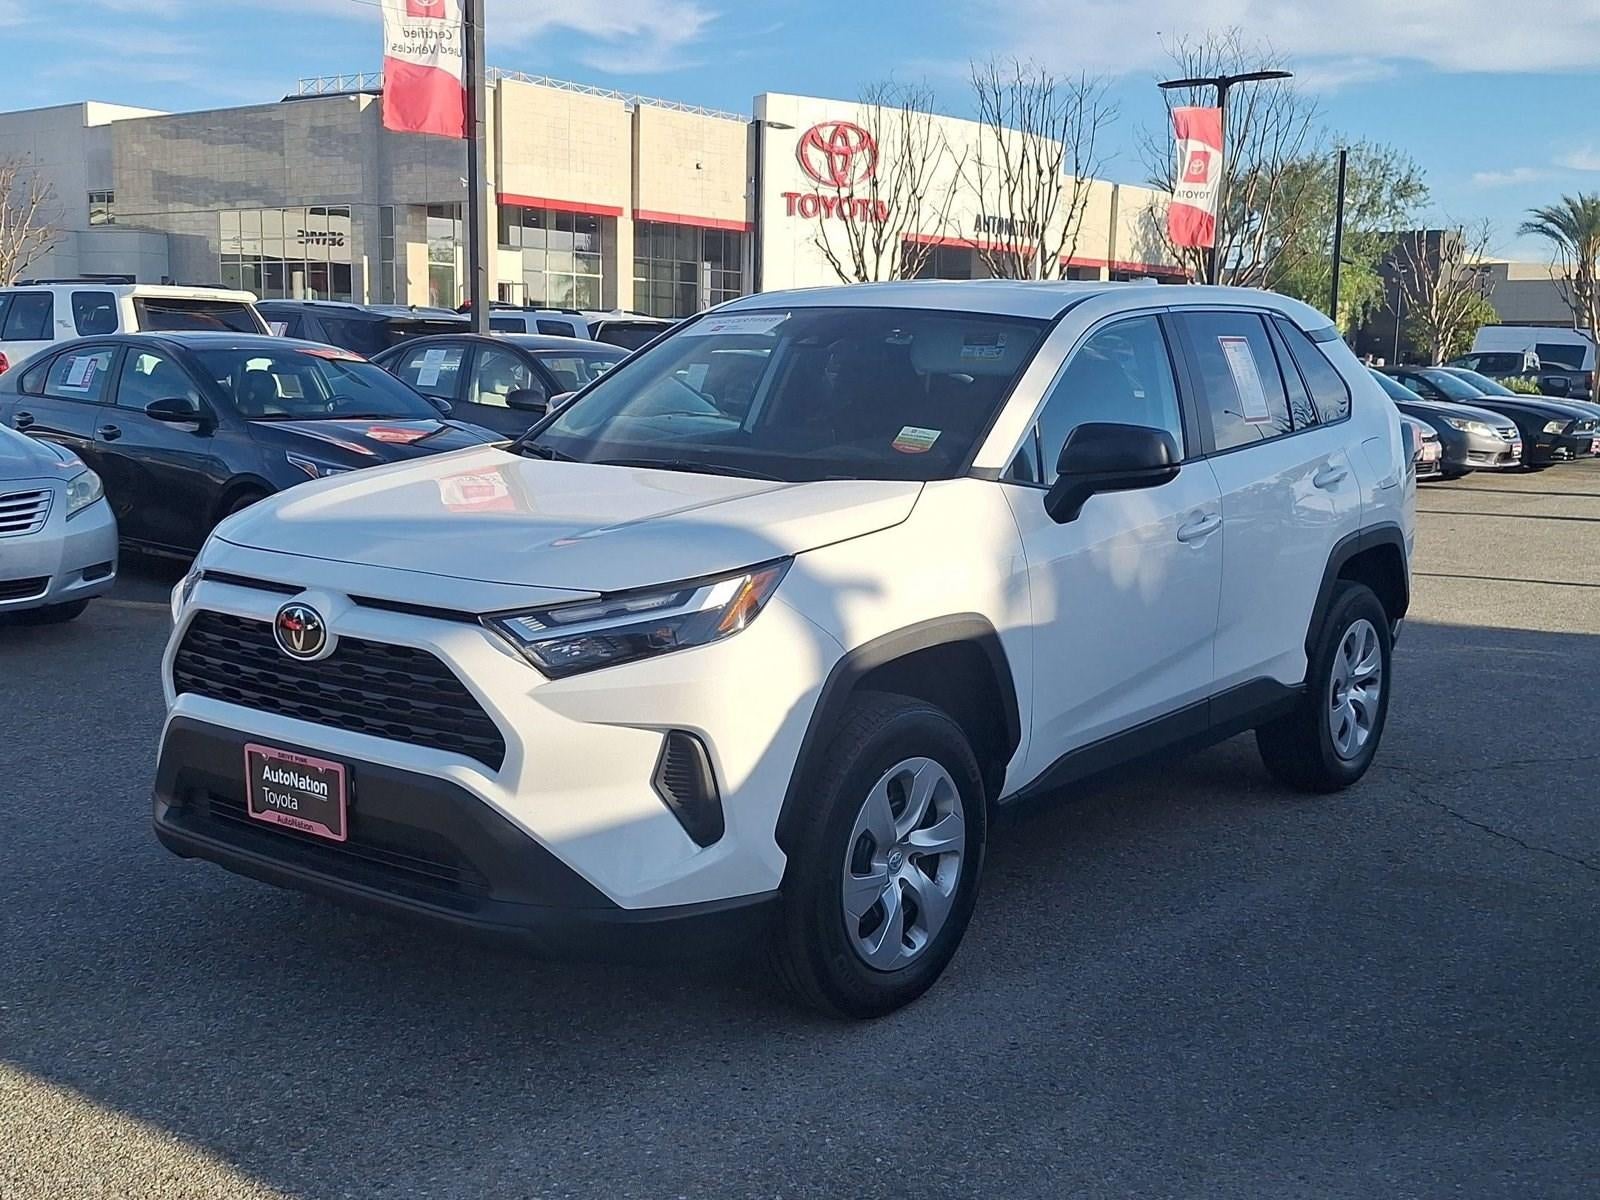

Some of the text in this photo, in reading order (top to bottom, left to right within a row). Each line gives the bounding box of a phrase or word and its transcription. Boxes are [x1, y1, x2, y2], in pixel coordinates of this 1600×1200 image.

[781, 191, 889, 222] TOYOTA
[263, 765, 328, 795] AutoNation
[262, 787, 298, 810] Toyota
[277, 815, 314, 831] AutoNation
